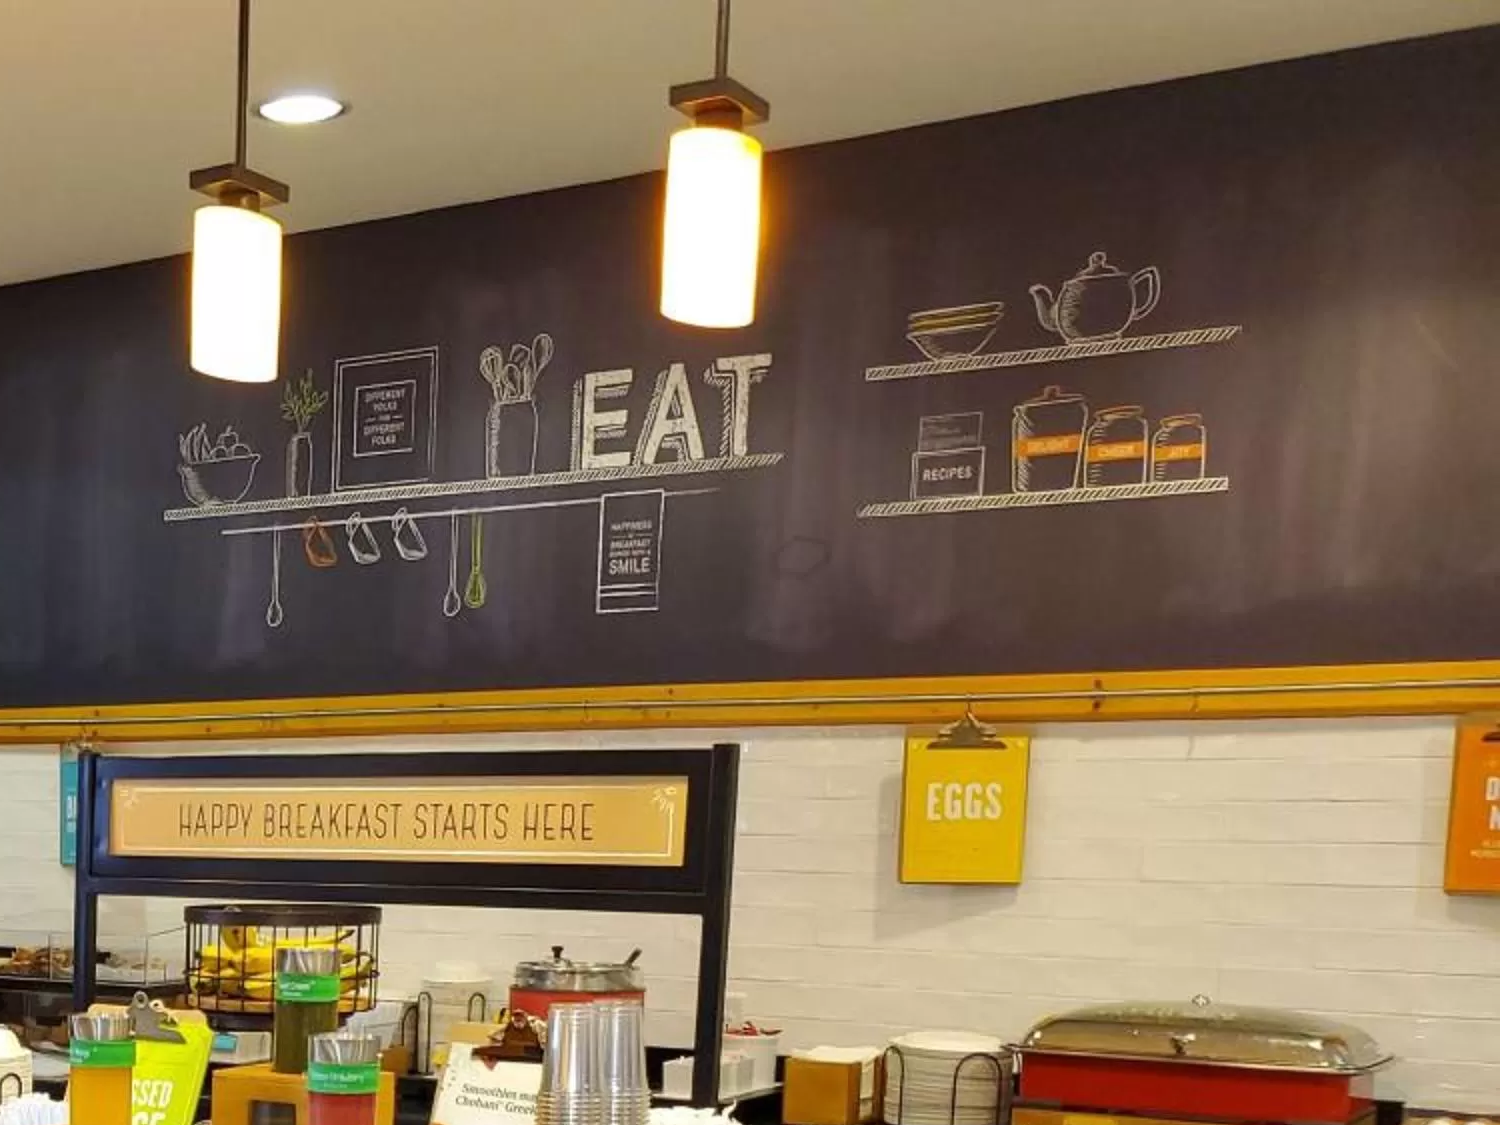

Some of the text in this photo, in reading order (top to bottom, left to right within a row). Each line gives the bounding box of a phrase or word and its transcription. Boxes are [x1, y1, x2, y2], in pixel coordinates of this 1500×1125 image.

[573, 353, 773, 471] EAT
[923, 466, 973, 481] RECIPES
[609, 557, 651, 575] SMILE
[926, 781, 1002, 821] EGGS
[179, 803, 595, 842] HAPPY BREAKFAST STARTS HERE
